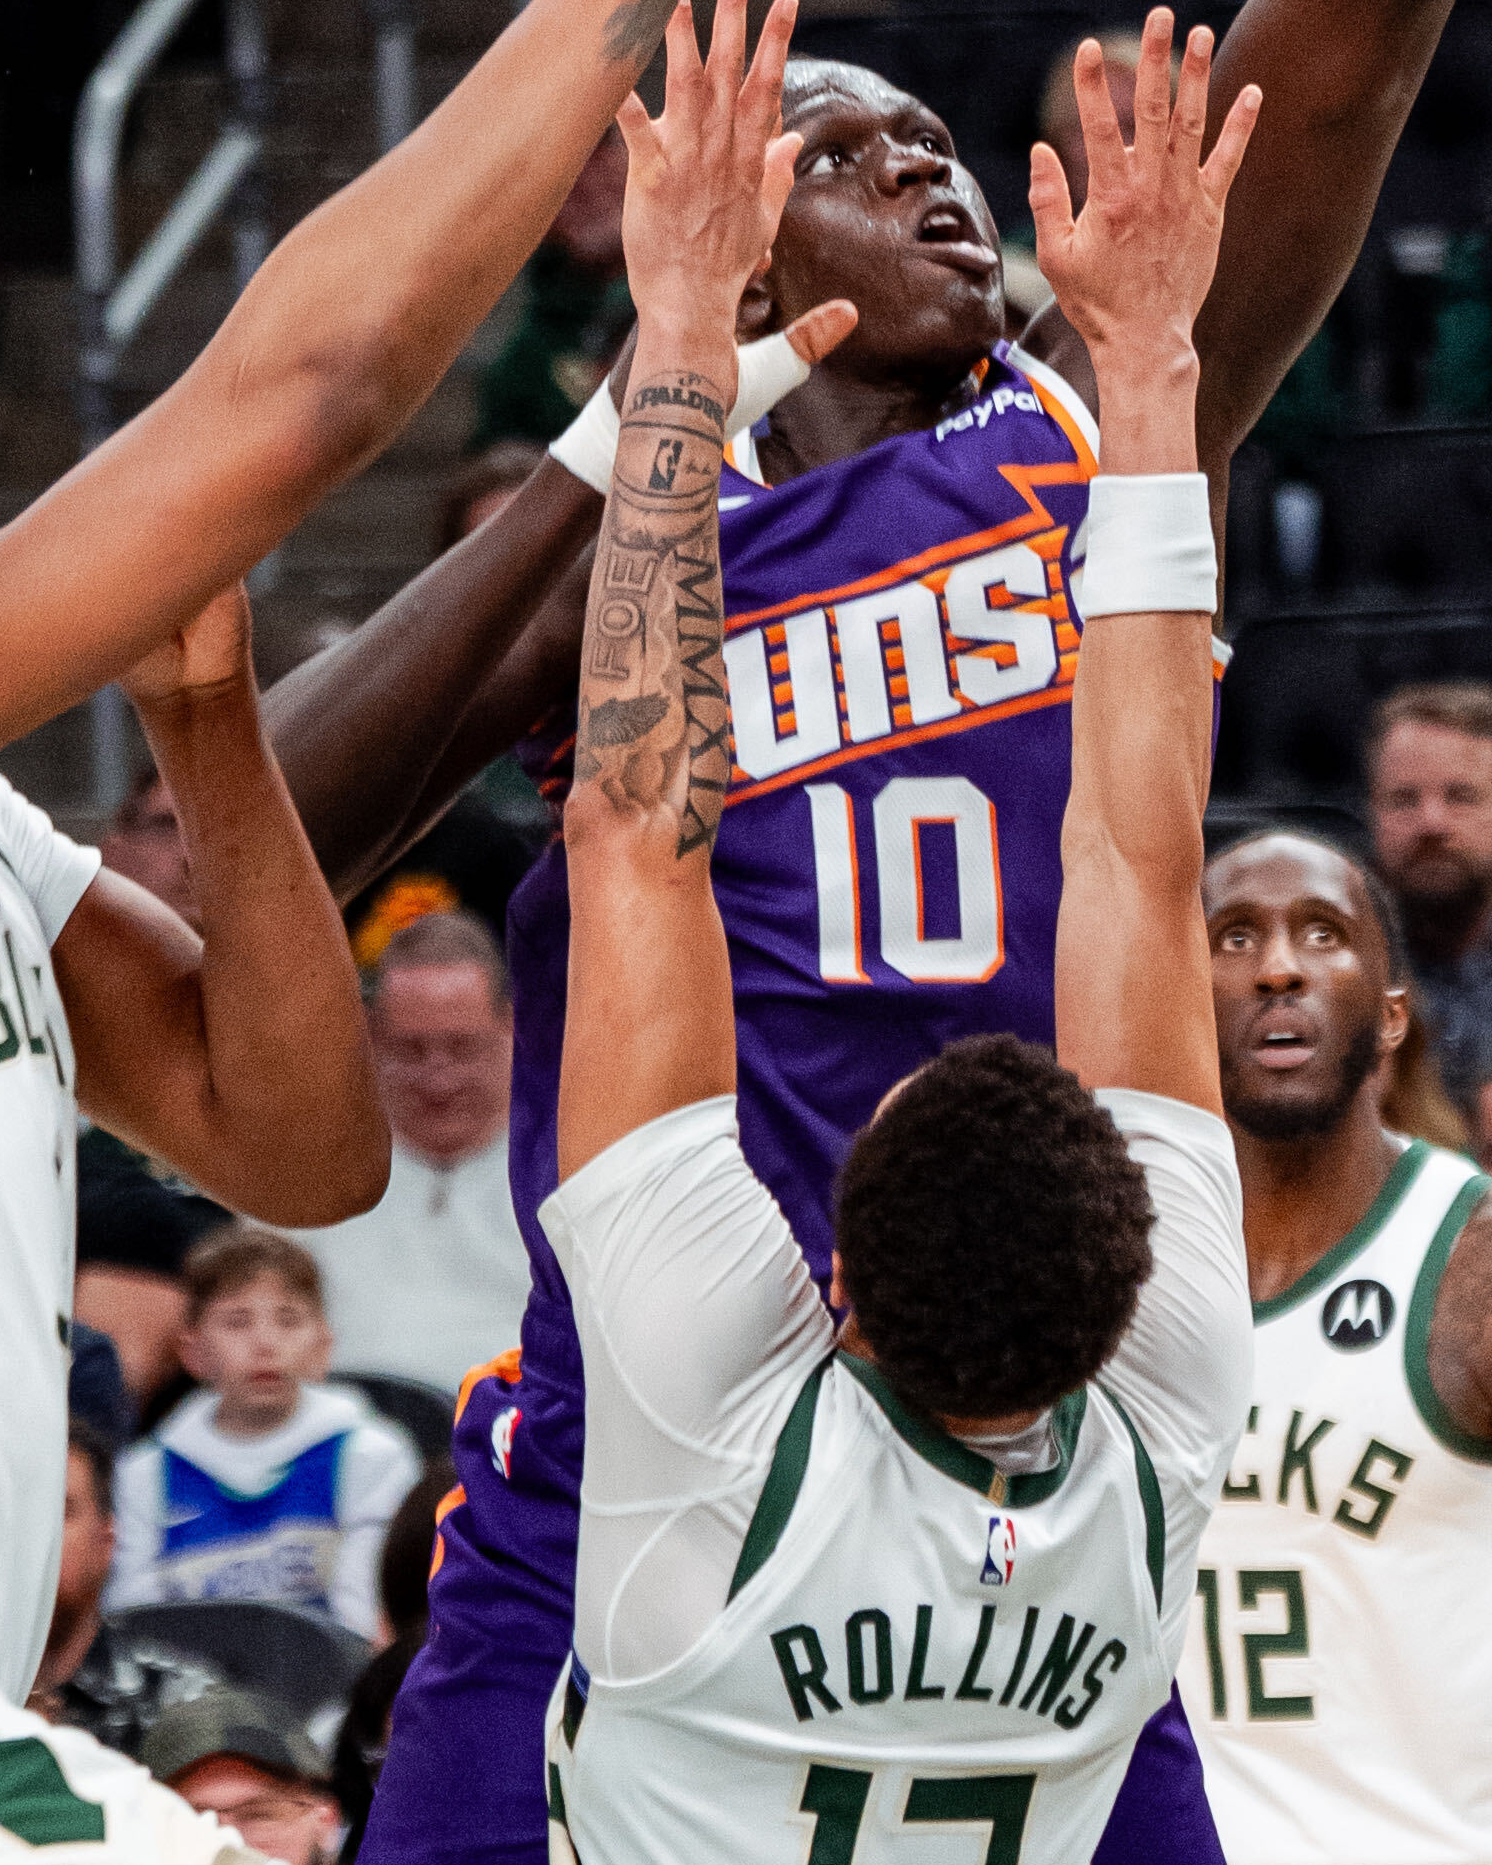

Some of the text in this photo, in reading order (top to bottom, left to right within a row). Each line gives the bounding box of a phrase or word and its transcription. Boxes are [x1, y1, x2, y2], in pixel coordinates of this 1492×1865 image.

[804, 775, 1007, 985] 10
[768, 1602, 1129, 1732] ROLLINS
[1197, 1566, 1317, 1723] 12
